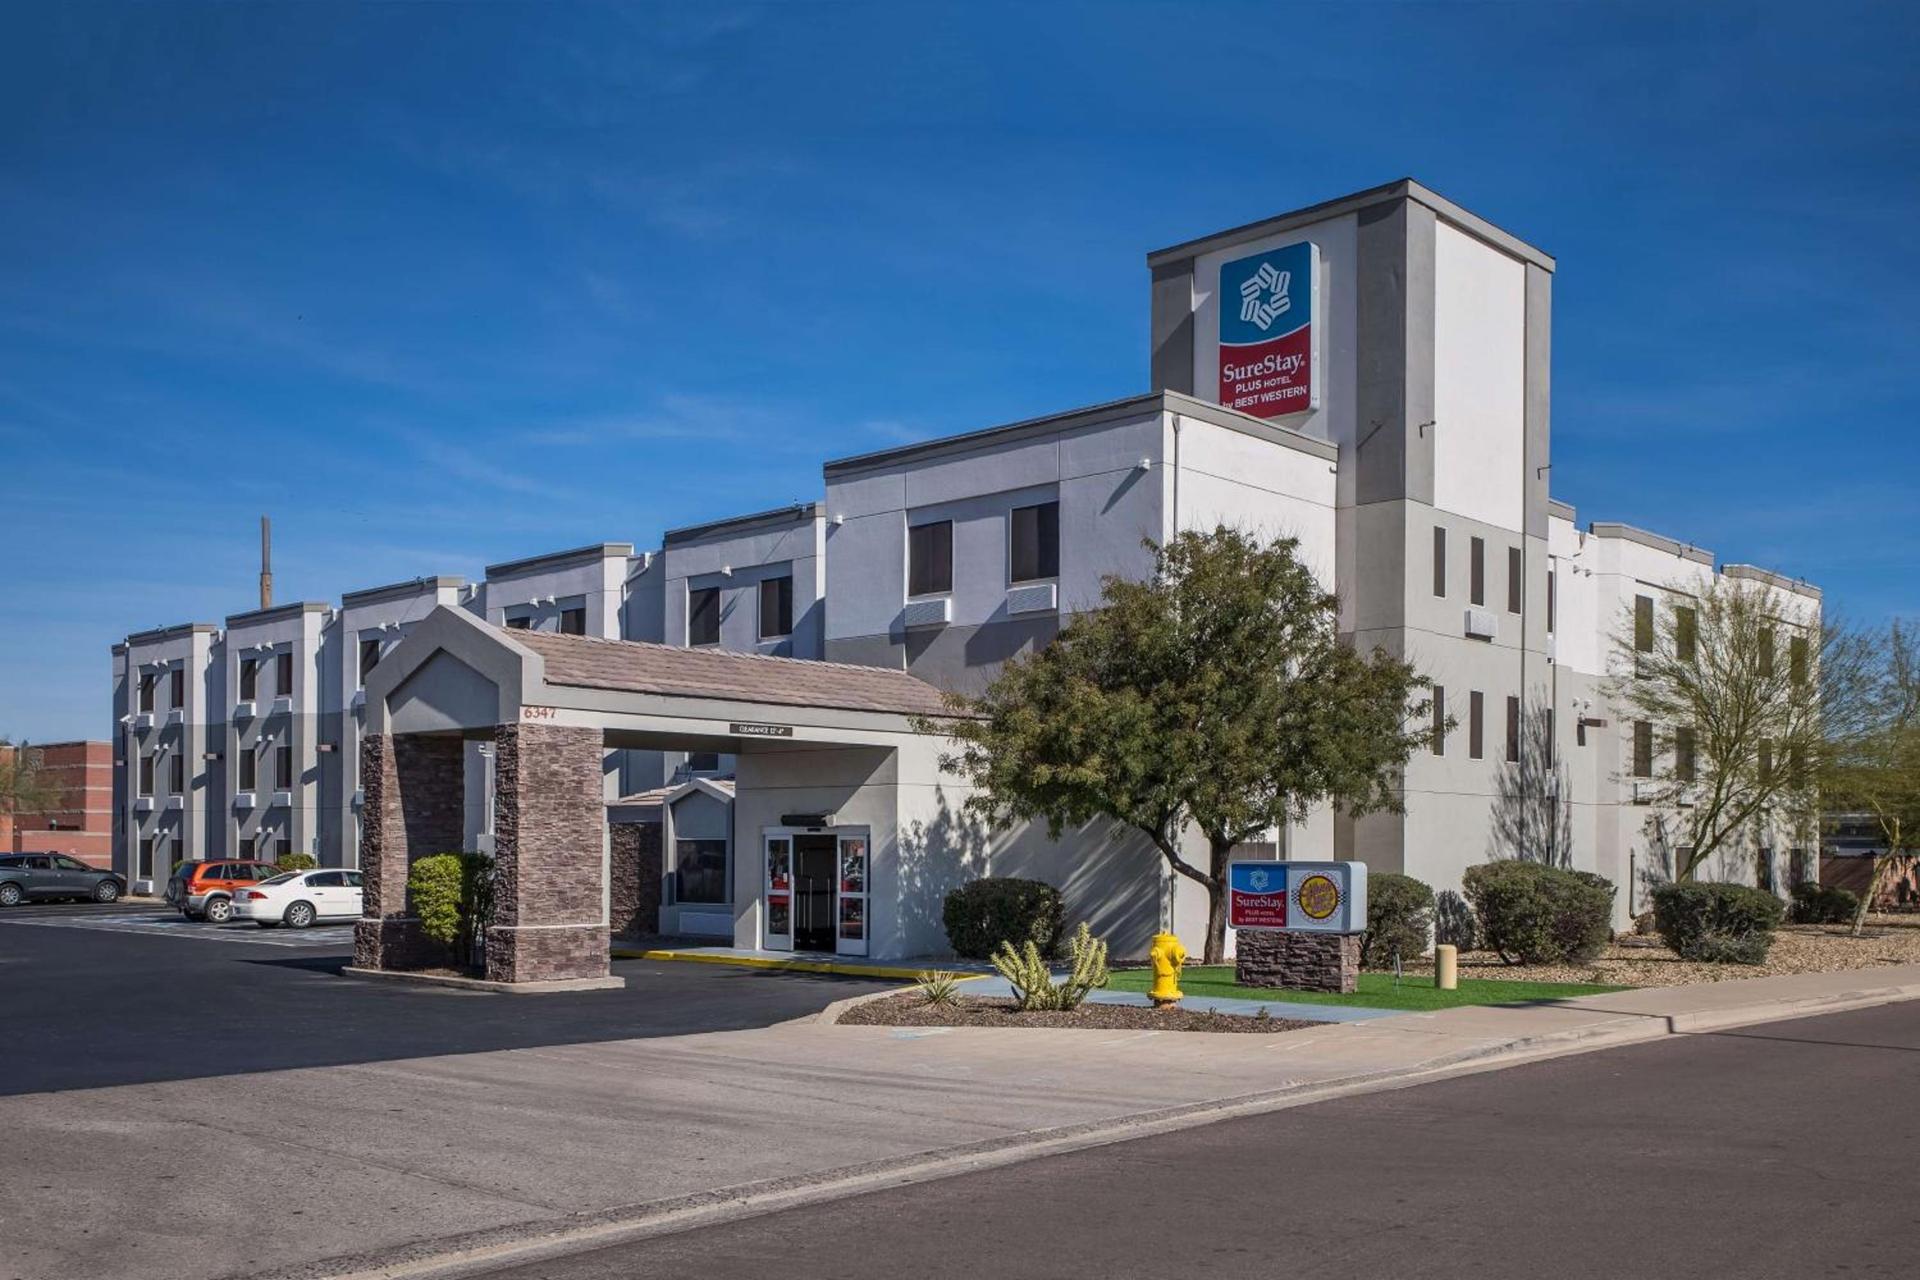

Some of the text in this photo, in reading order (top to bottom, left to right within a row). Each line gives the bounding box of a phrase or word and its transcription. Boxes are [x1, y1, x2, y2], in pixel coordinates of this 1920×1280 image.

[1223, 353, 1302, 382] SureStay
[1235, 376, 1291, 394] PLUS HOTEL
[1235, 395, 1260, 408] BEST
[1260, 385, 1306, 403] WESTERN
[524, 706, 556, 719] 6347
[1236, 895, 1282, 911] SureStay
